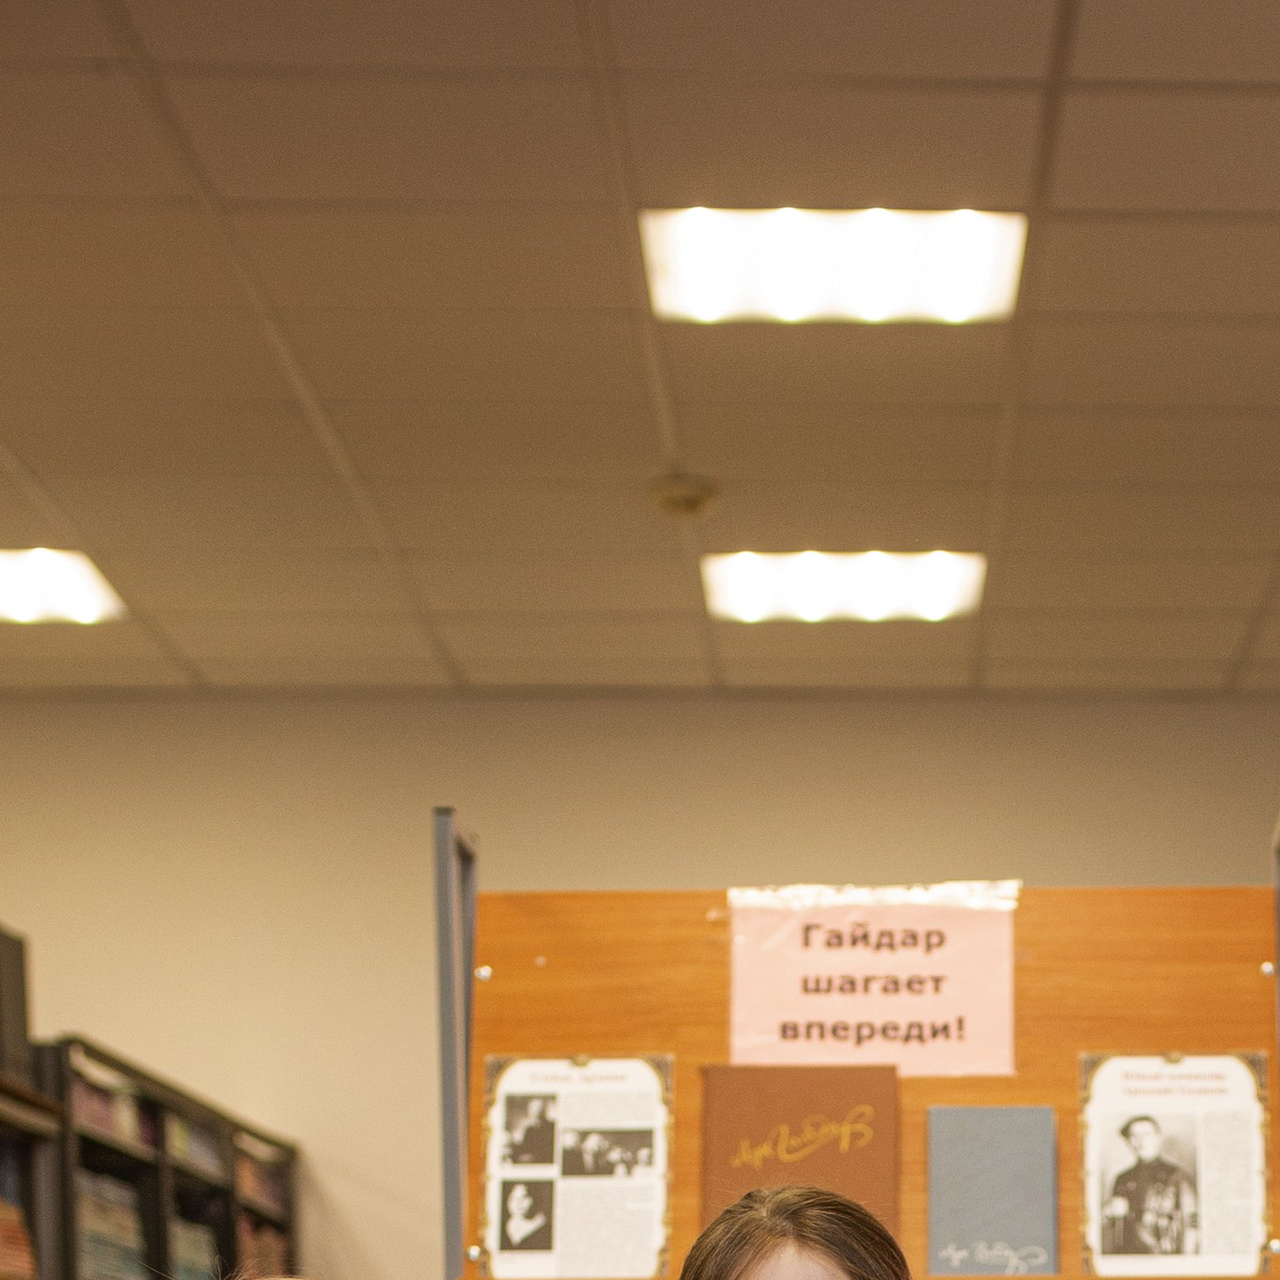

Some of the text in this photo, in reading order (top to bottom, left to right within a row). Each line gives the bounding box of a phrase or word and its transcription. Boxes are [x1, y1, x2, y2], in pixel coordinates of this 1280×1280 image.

[801, 923, 948, 955] Гайдар
[801, 972, 948, 996] шагает
[778, 1015, 968, 1047] впереди!
